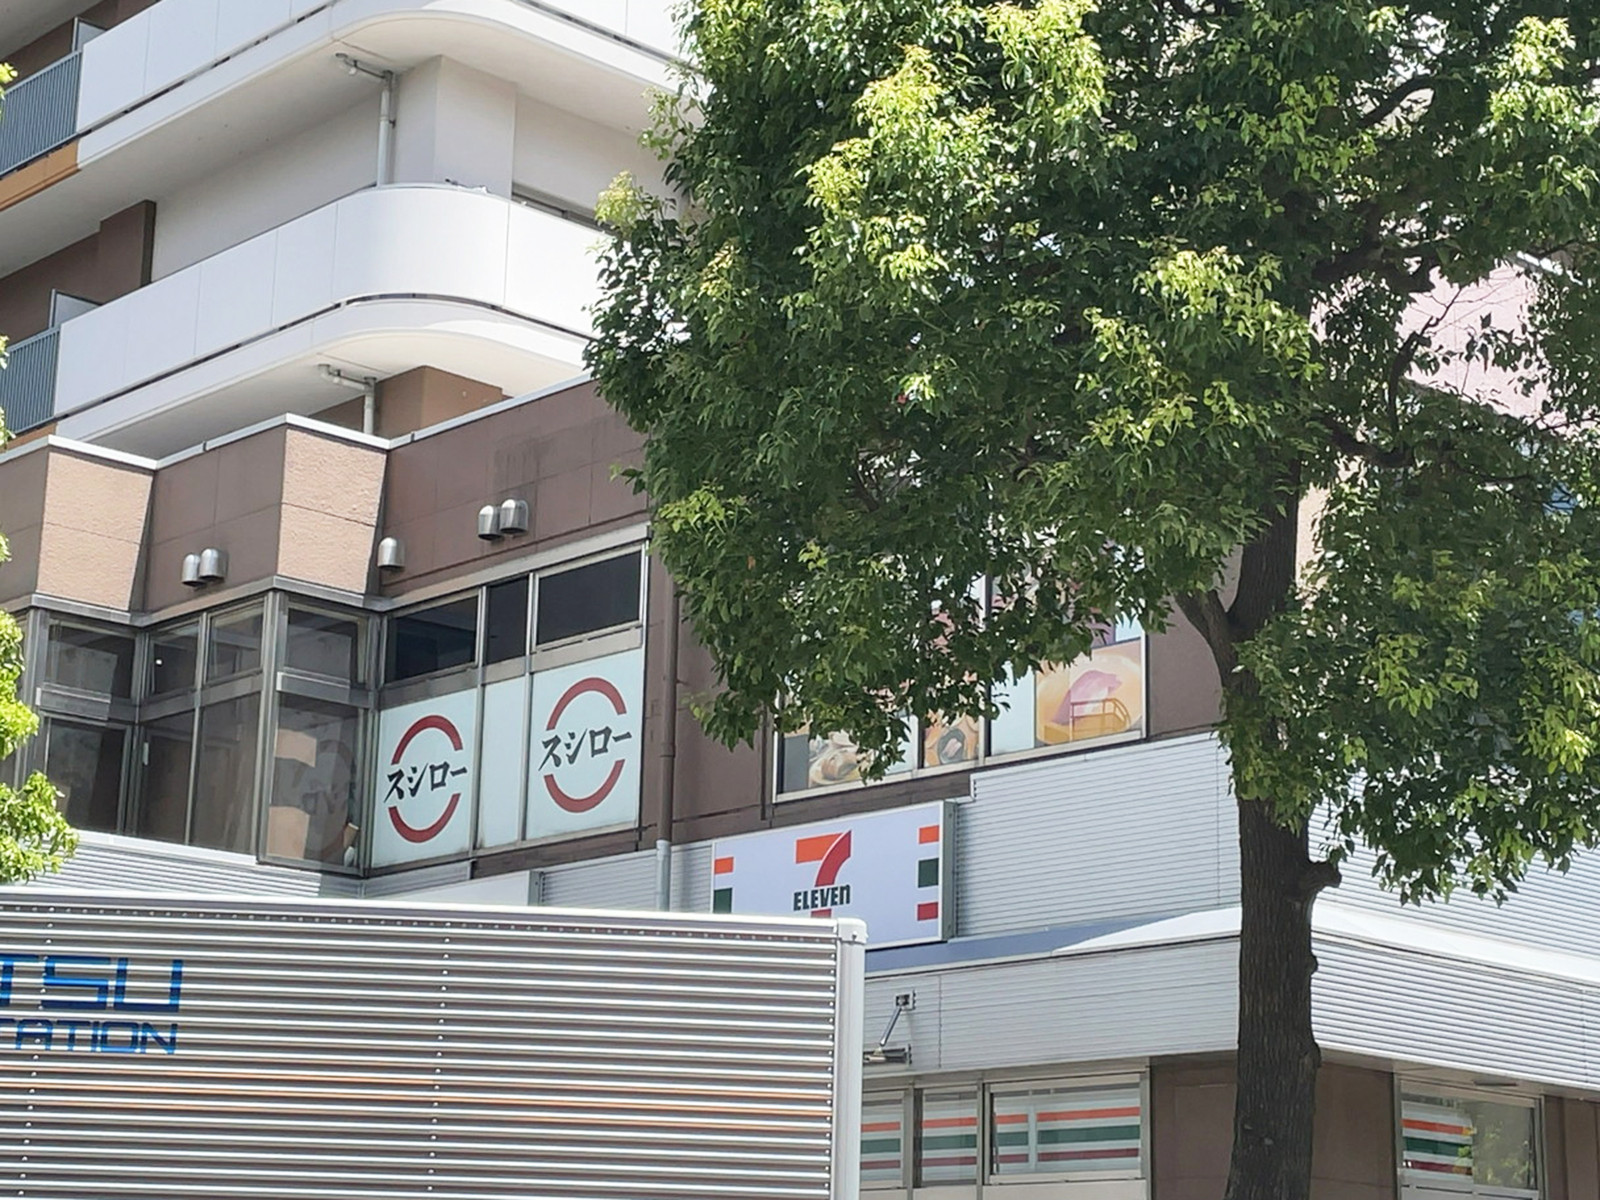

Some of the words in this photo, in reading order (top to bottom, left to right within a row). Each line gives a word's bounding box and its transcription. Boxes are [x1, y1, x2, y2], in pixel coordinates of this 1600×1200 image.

[538, 726, 632, 771] スシロー
[384, 761, 467, 803] スシロー
[795, 829, 852, 917] 7
